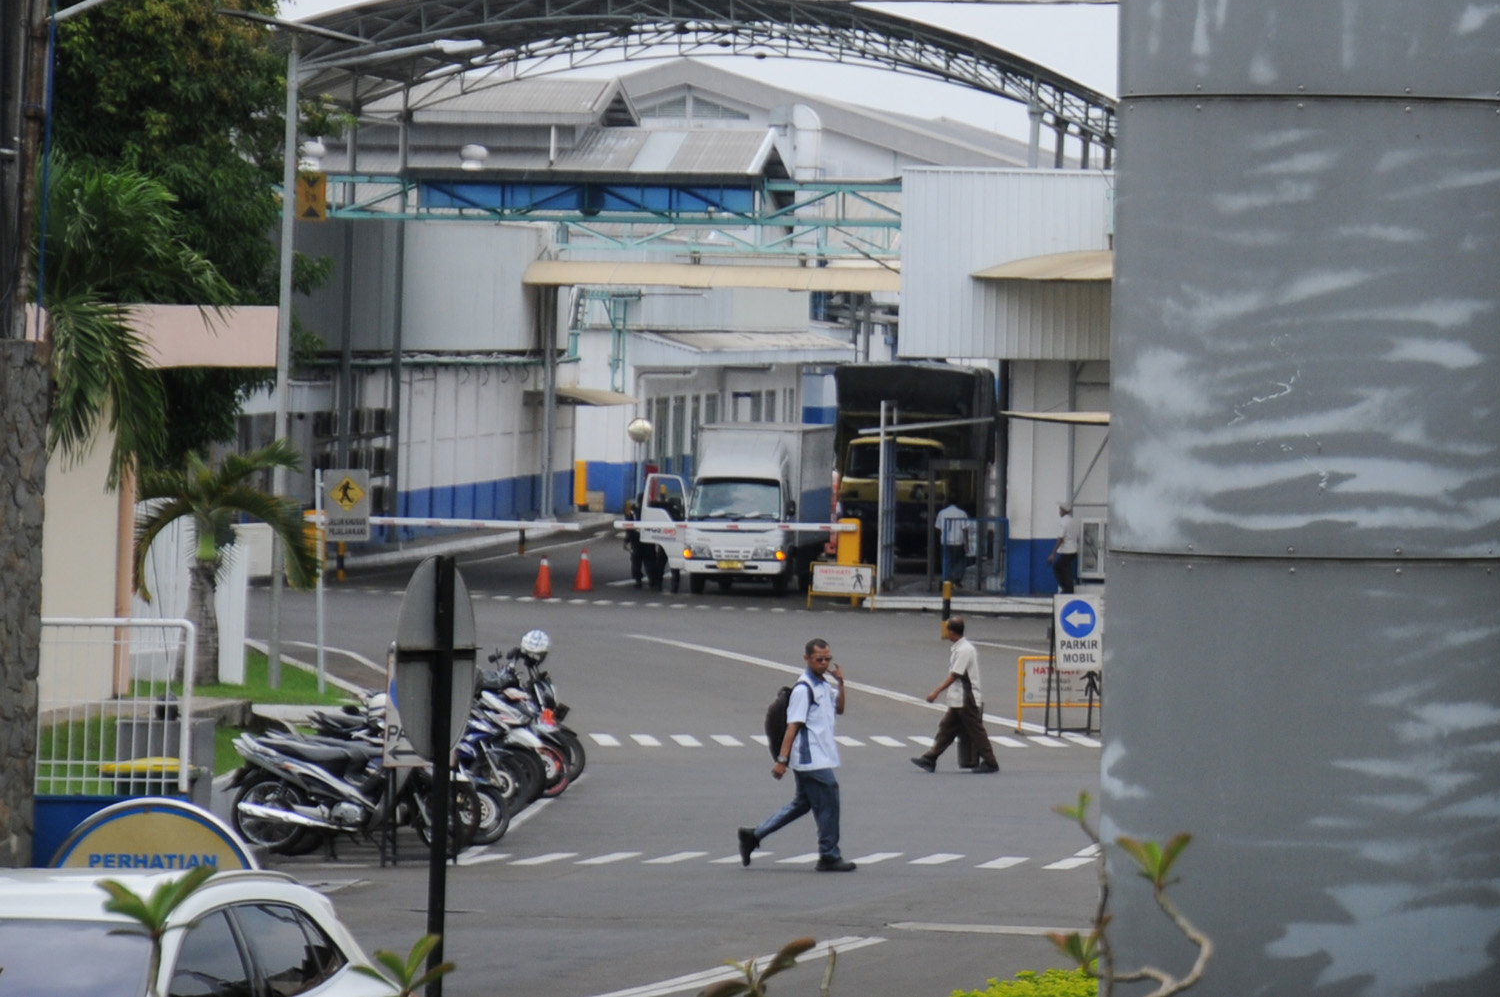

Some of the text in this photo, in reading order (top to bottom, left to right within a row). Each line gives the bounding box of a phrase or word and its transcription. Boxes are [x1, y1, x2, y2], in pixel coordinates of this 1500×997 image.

[1060, 640, 1098, 650] PARKIR
[1063, 654, 1096, 663] MOBIL
[88, 853, 218, 870] PERHATIAN
